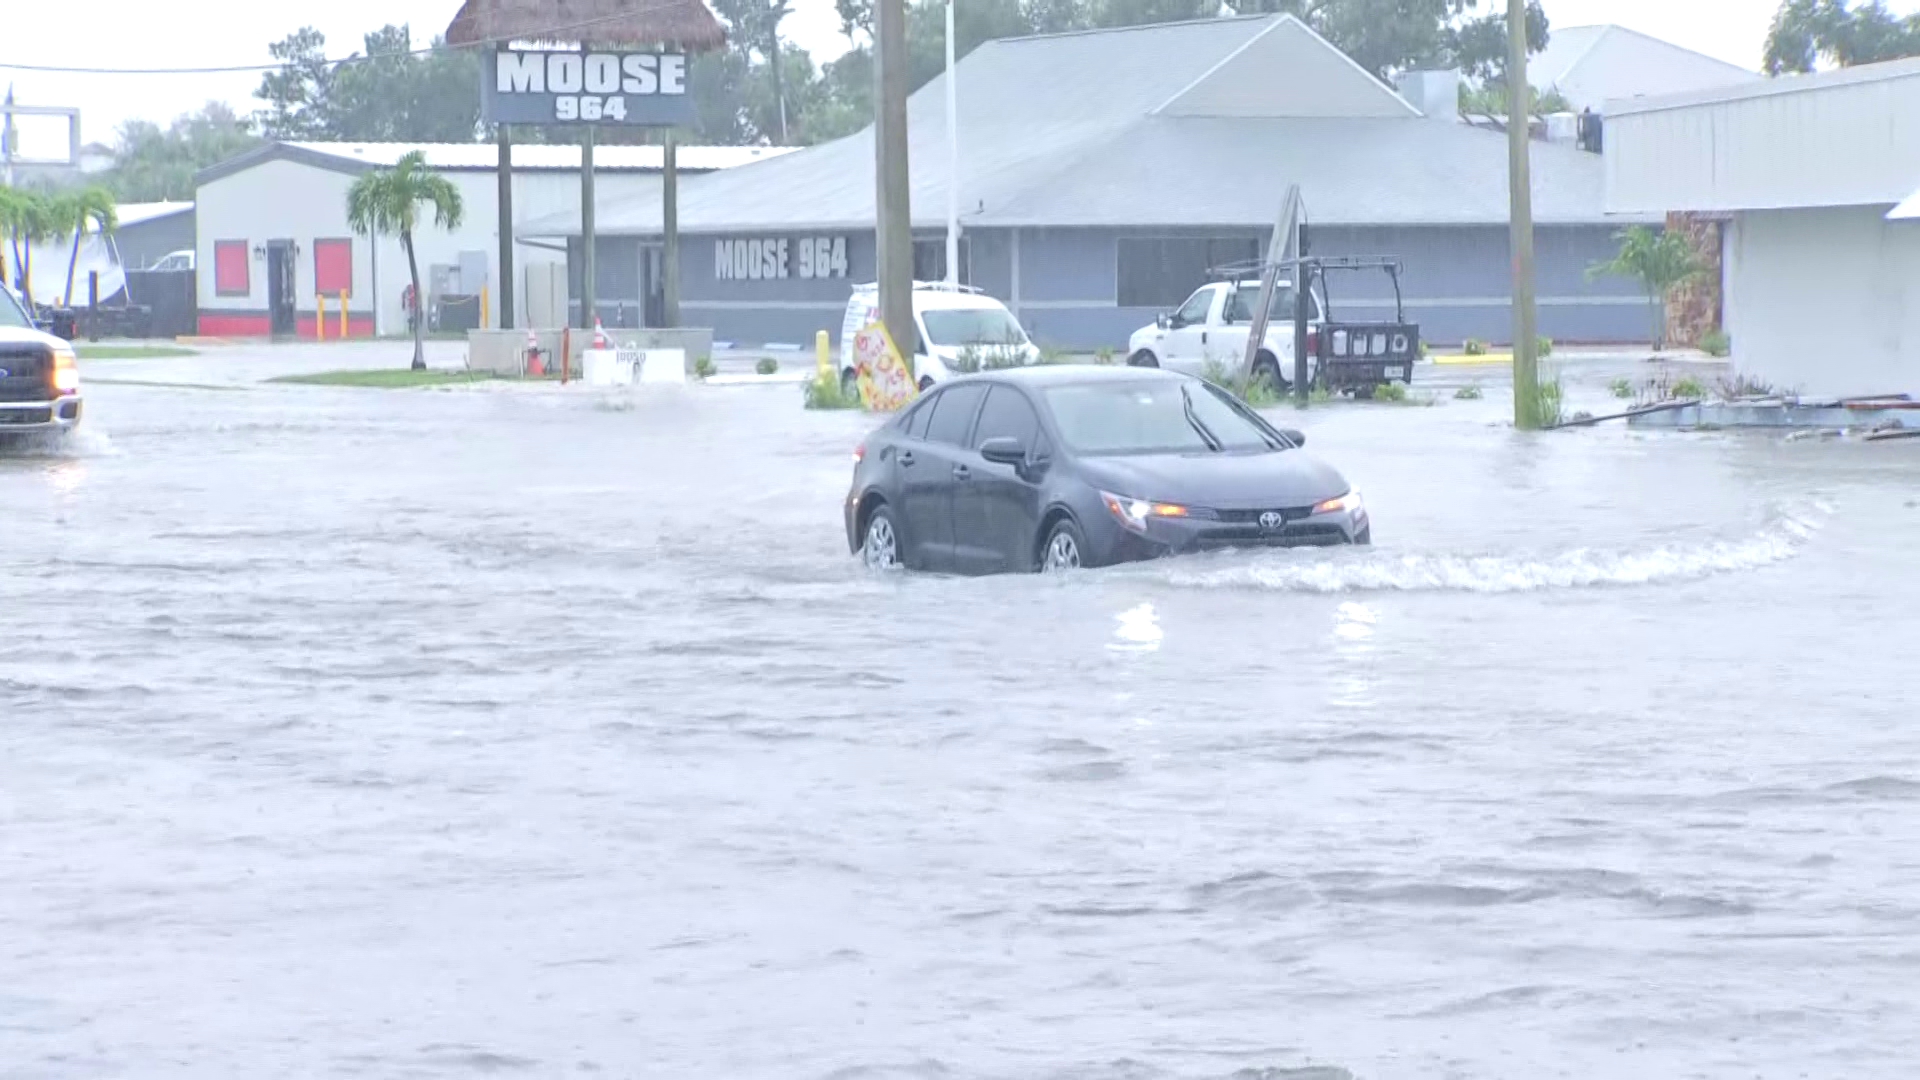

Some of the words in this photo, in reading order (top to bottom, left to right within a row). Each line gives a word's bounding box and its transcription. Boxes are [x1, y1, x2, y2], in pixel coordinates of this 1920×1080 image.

[496, 52, 686, 94] MOOSE
[555, 96, 627, 121] 964
[715, 239, 788, 279] MOOSE
[799, 238, 848, 279] 964
